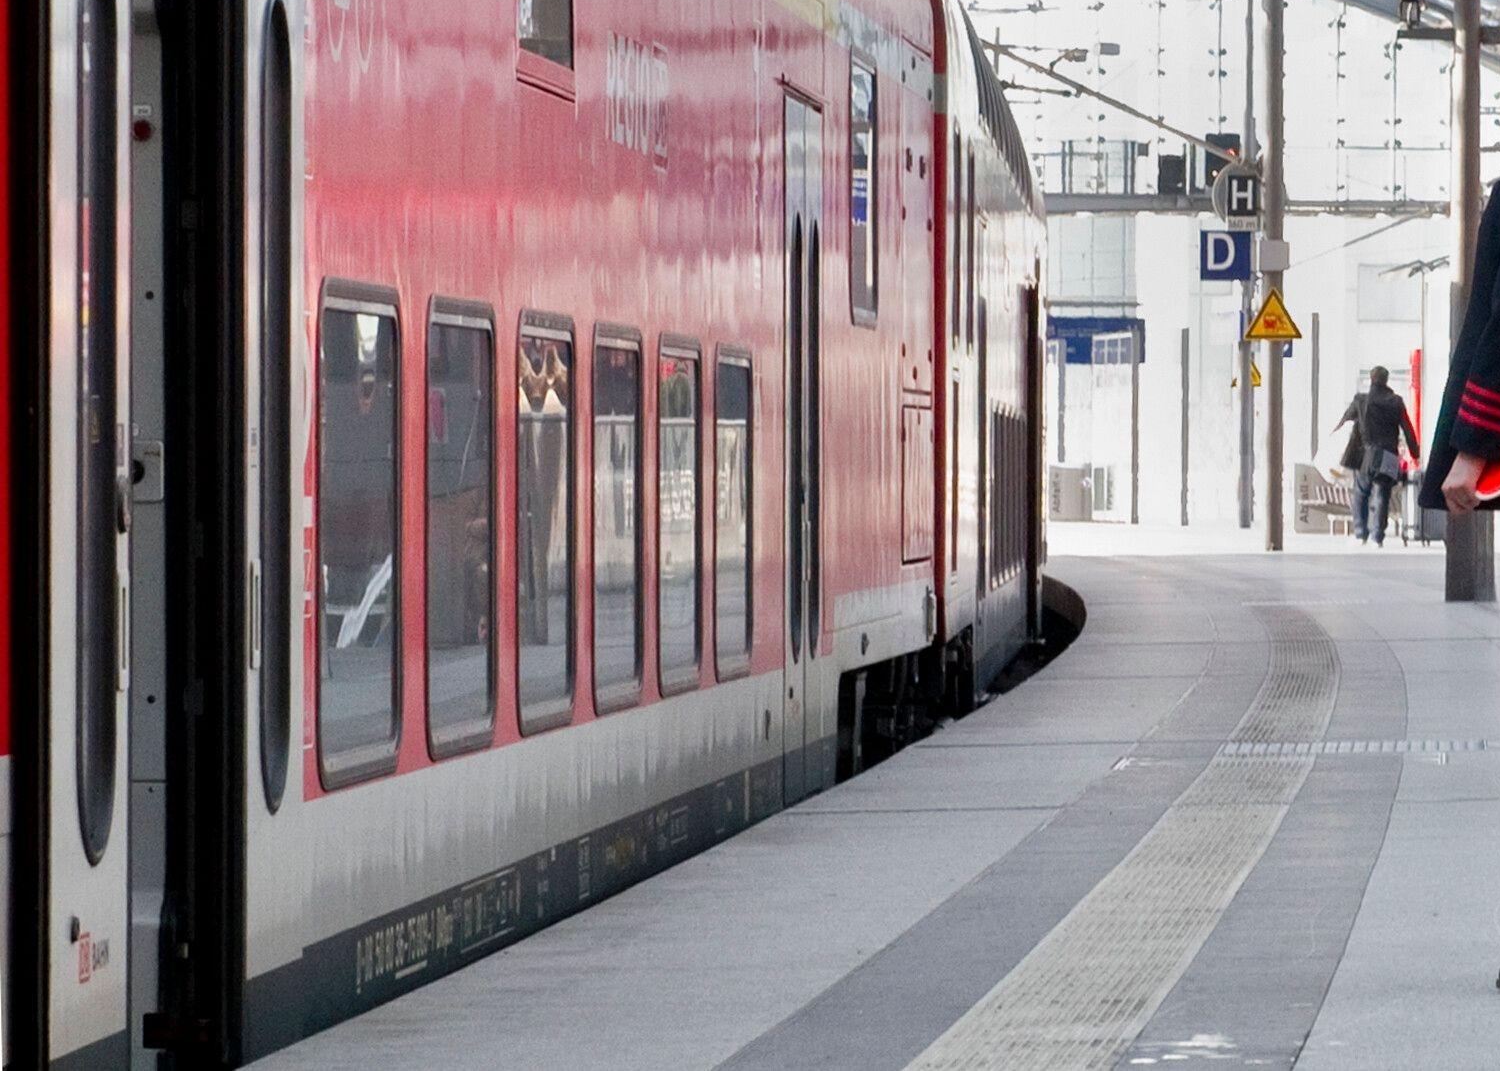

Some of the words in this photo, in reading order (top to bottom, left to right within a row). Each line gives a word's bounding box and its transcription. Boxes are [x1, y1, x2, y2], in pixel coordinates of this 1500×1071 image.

[605, 29, 650, 157] REGIO
[1231, 178, 1253, 211] H
[1206, 232, 1236, 271] D
[1299, 485, 1309, 524] Aball
